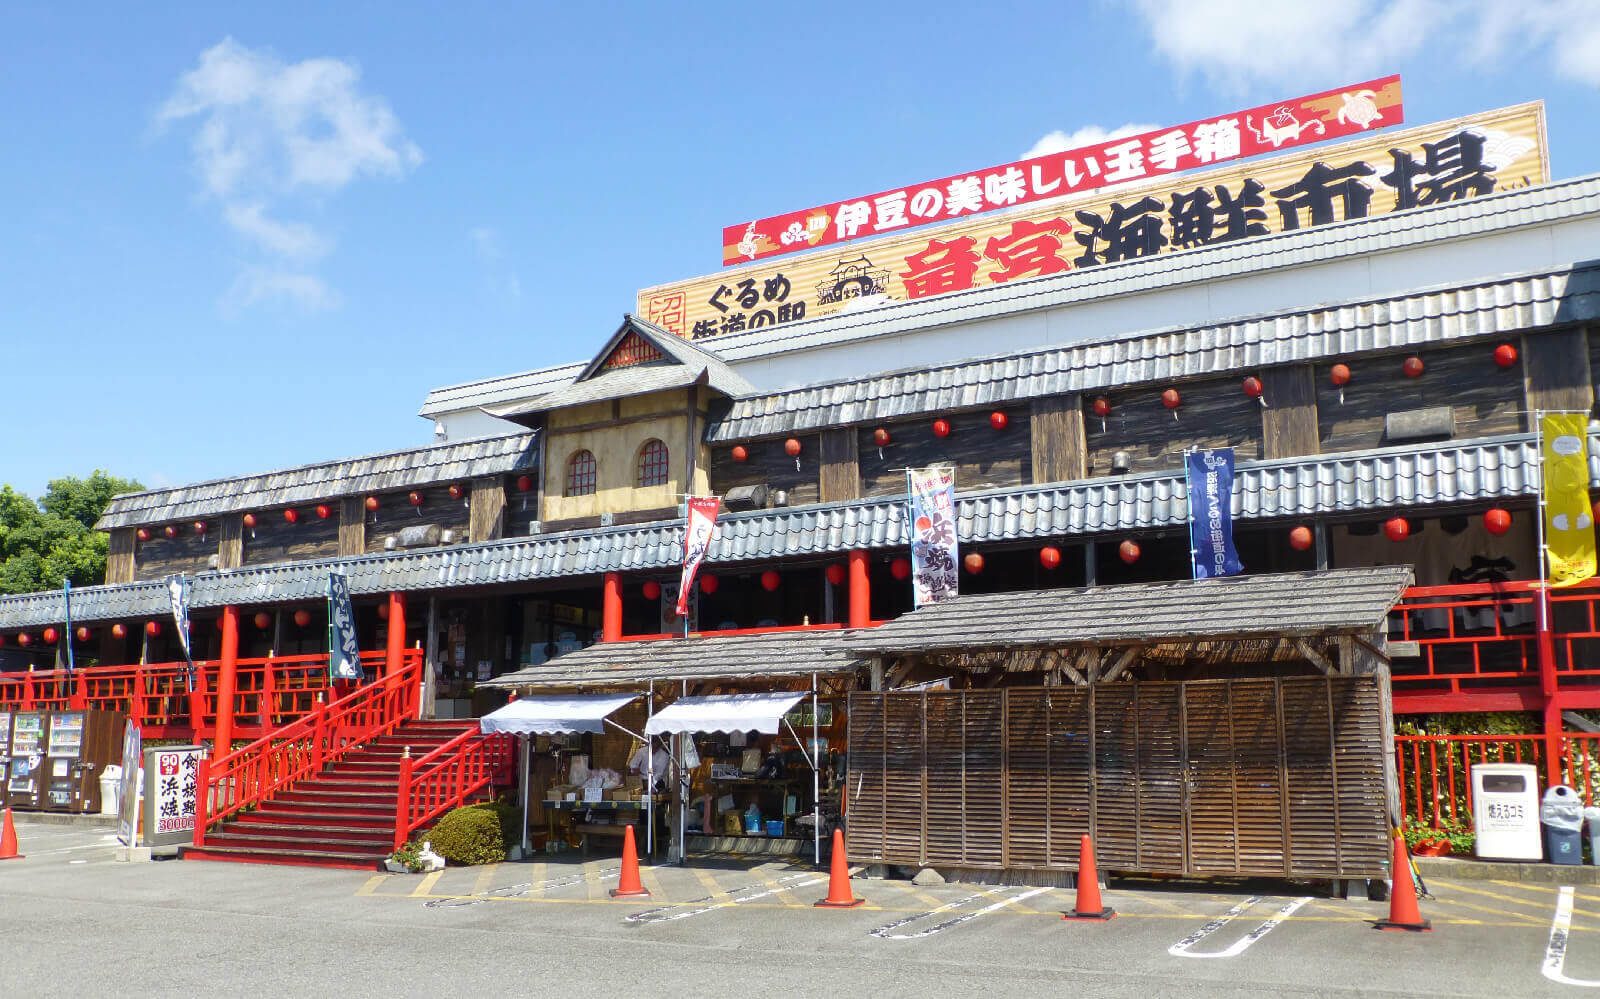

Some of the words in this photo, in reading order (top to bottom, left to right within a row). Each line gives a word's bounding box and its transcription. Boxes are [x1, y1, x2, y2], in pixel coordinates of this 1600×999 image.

[834, 118, 1242, 241] 伊豆の美味しい玉手箱
[708, 273, 791, 313] ぐるめ
[160, 776, 180, 817] 浜焼
[182, 752, 197, 816] 食べ放題
